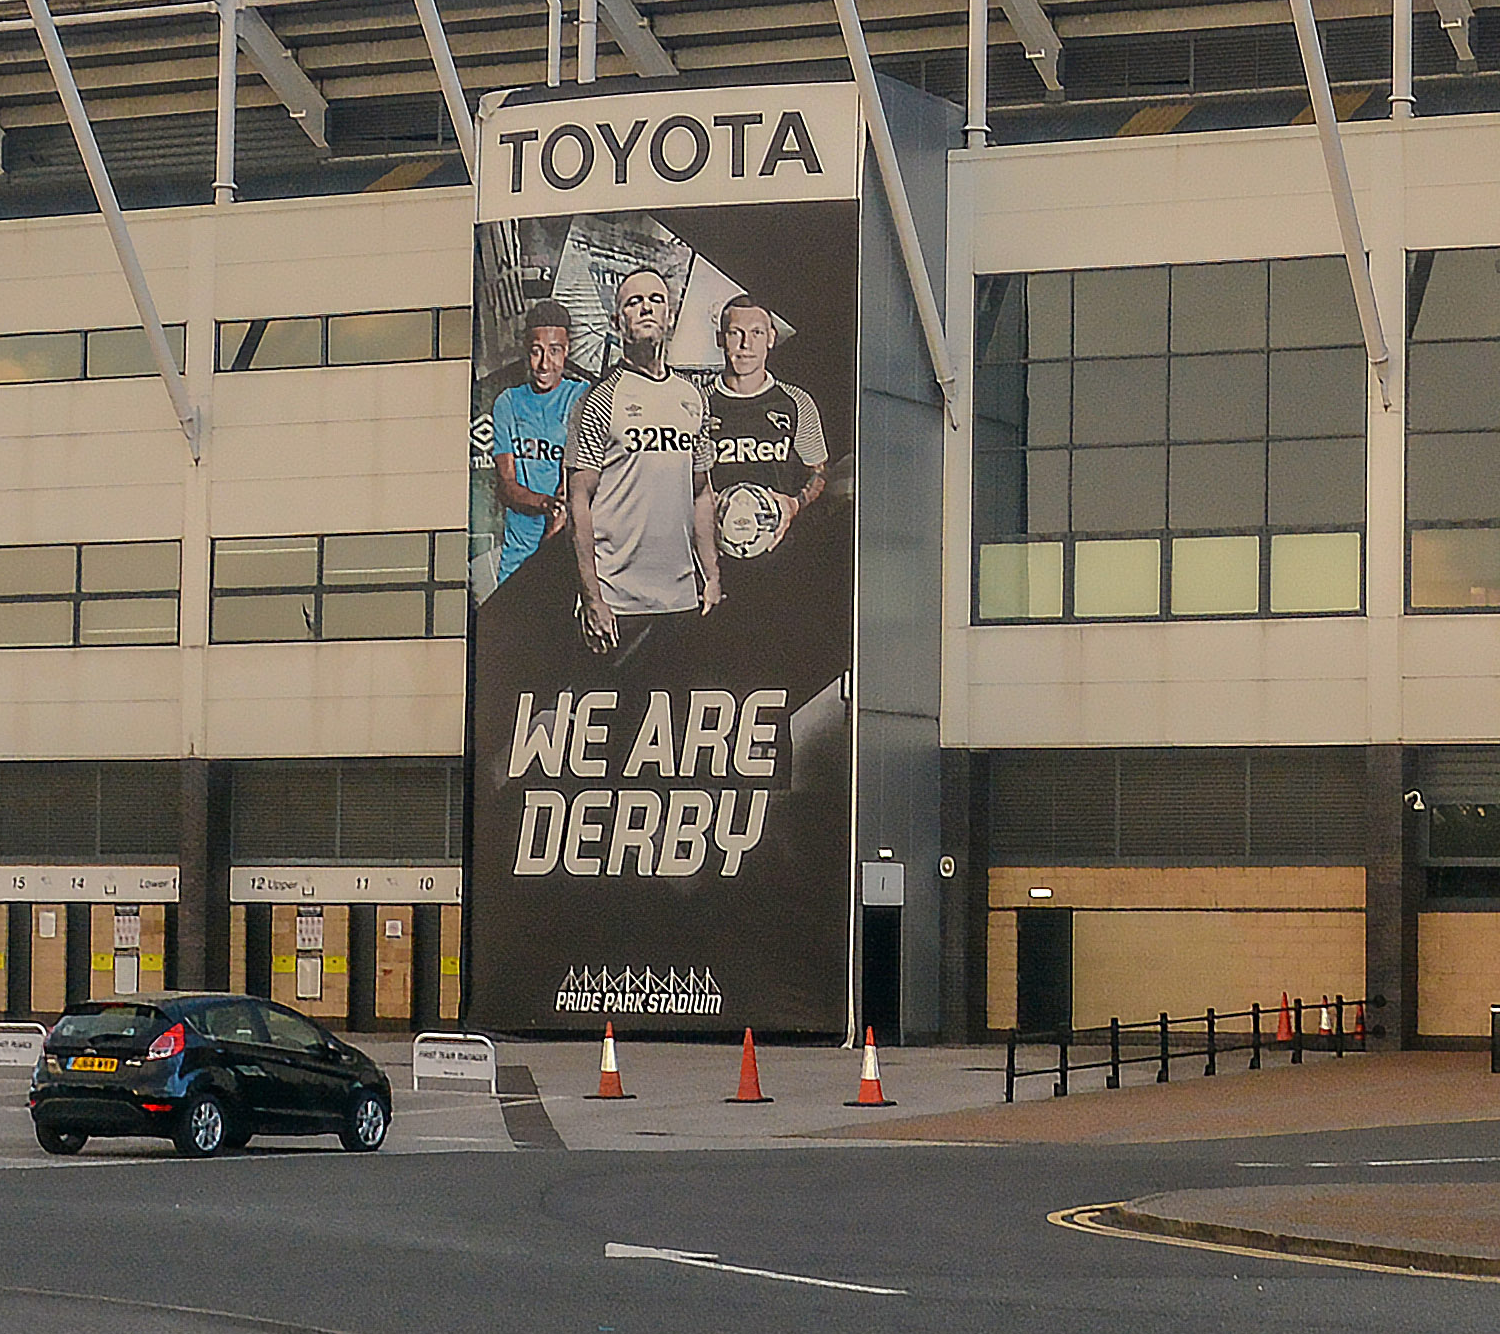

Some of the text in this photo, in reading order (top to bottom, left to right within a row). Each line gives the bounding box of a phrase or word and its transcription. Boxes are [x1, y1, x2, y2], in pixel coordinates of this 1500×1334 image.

[498, 109, 825, 195] TOYOTA
[512, 436, 565, 463] 32Re
[507, 689, 788, 778] WE ARE
[512, 789, 769, 877] DERBY
[12, 876, 26, 890] 15
[70, 876, 85, 890] 14
[250, 876, 266, 890] 12
[355, 877, 370, 891] 11
[418, 876, 435, 891] 10
[555, 991, 723, 1015] PRIDE PARK STADIUM
